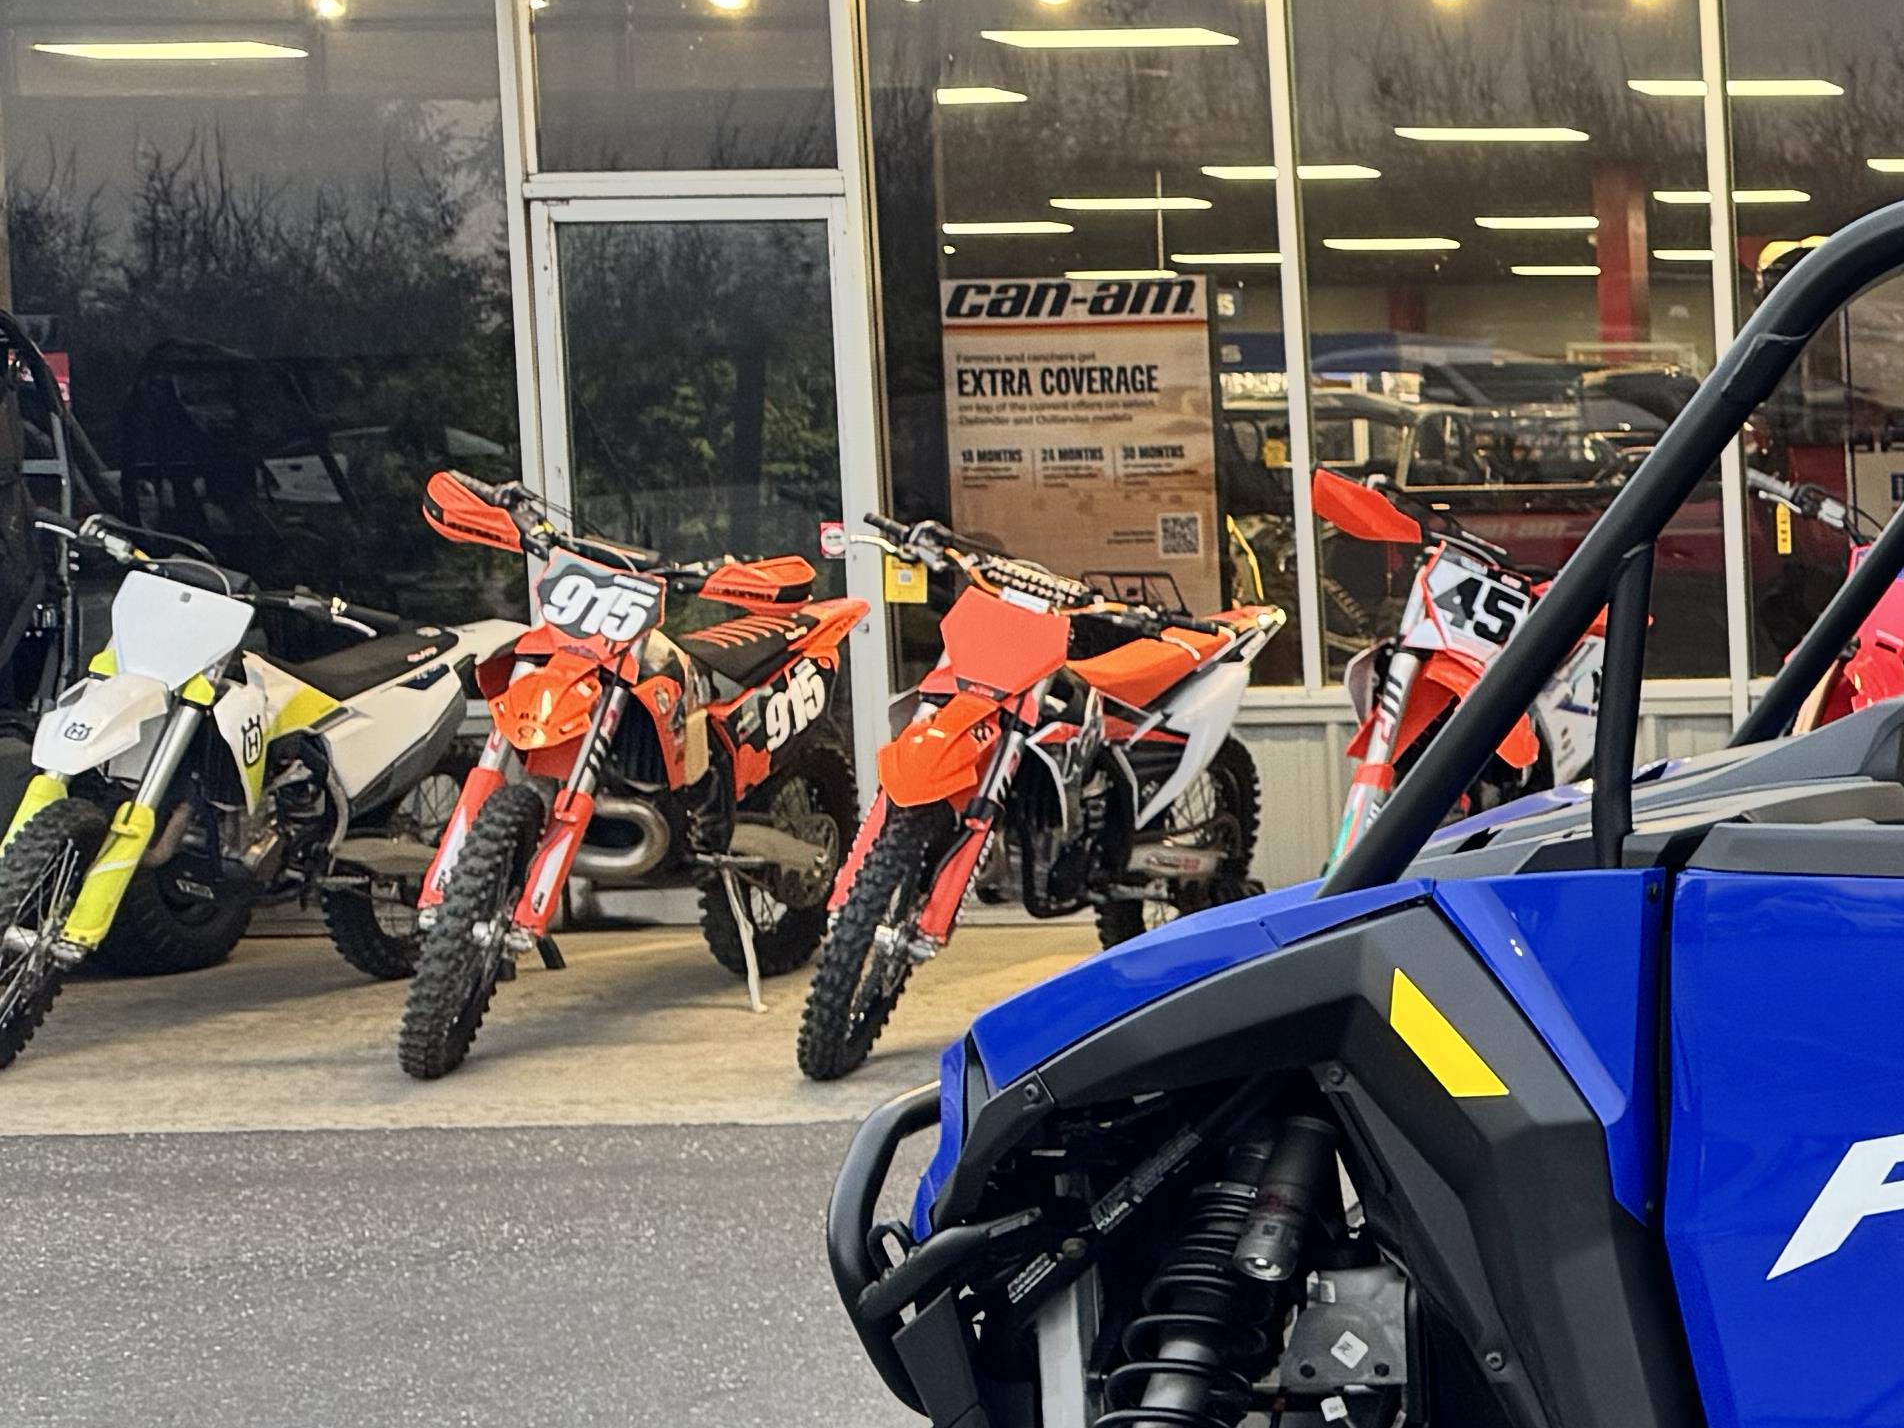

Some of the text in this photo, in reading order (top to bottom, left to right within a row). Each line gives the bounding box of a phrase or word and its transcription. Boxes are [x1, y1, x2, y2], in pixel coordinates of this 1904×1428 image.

[957, 365, 1160, 397] EXTRA COVERAGE
[976, 448, 1023, 464] MONTHS
[1058, 446, 1105, 462] MONTHS
[1138, 444, 1185, 460] MONTHS
[543, 574, 655, 642] 915
[766, 666, 826, 752] 915
